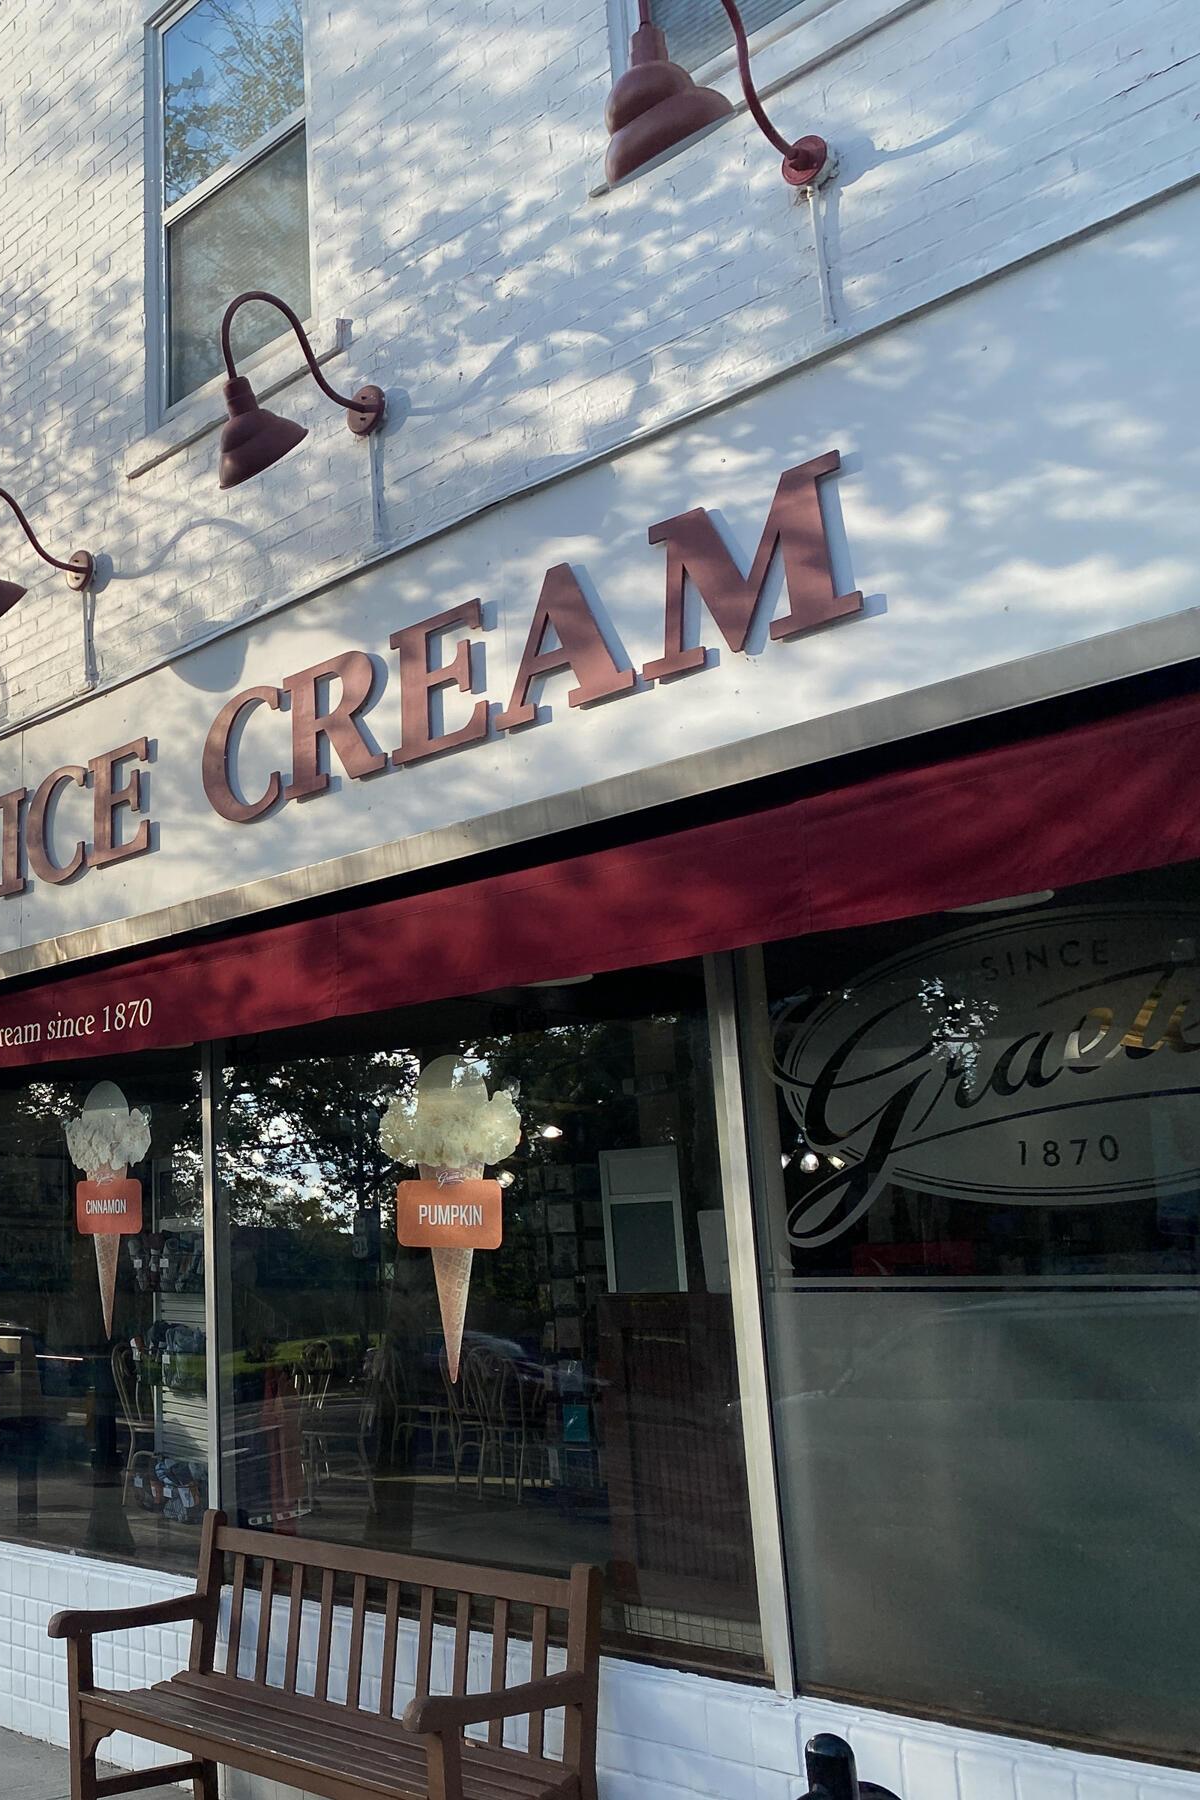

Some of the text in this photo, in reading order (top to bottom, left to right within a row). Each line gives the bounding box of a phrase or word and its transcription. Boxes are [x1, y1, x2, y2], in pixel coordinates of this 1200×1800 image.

[202, 450, 863, 823] CREAM
[981, 939, 1110, 982] SINCE
[47, 1011, 95, 1040] since
[102, 998, 152, 1033] 1870
[1018, 1135, 1119, 1167] 1870
[85, 1198, 127, 1214] CINNAMON
[418, 1204, 482, 1226] PUMPKIN
